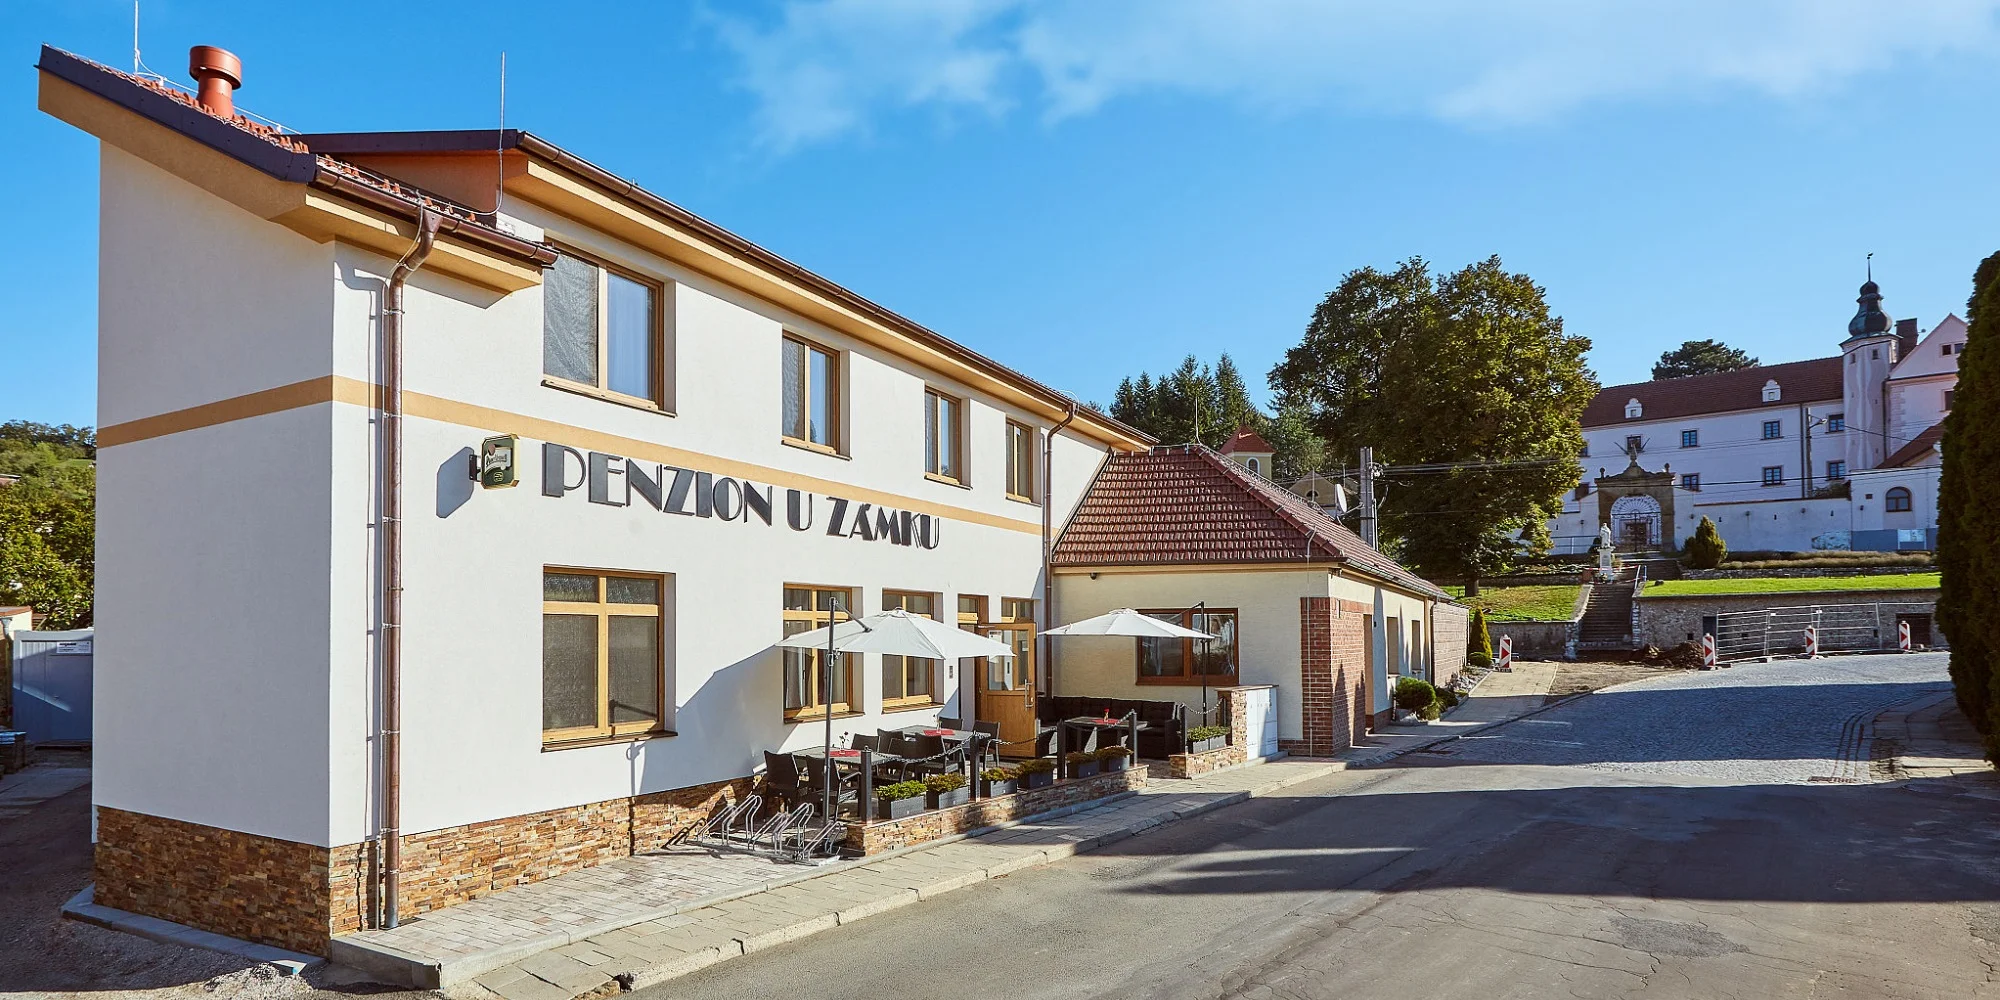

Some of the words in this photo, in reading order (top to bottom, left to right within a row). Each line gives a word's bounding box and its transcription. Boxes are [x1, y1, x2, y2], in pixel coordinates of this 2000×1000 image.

[542, 442, 772, 527] PENZION
[787, 489, 813, 531] U
[827, 497, 940, 549] ZÁMKU
